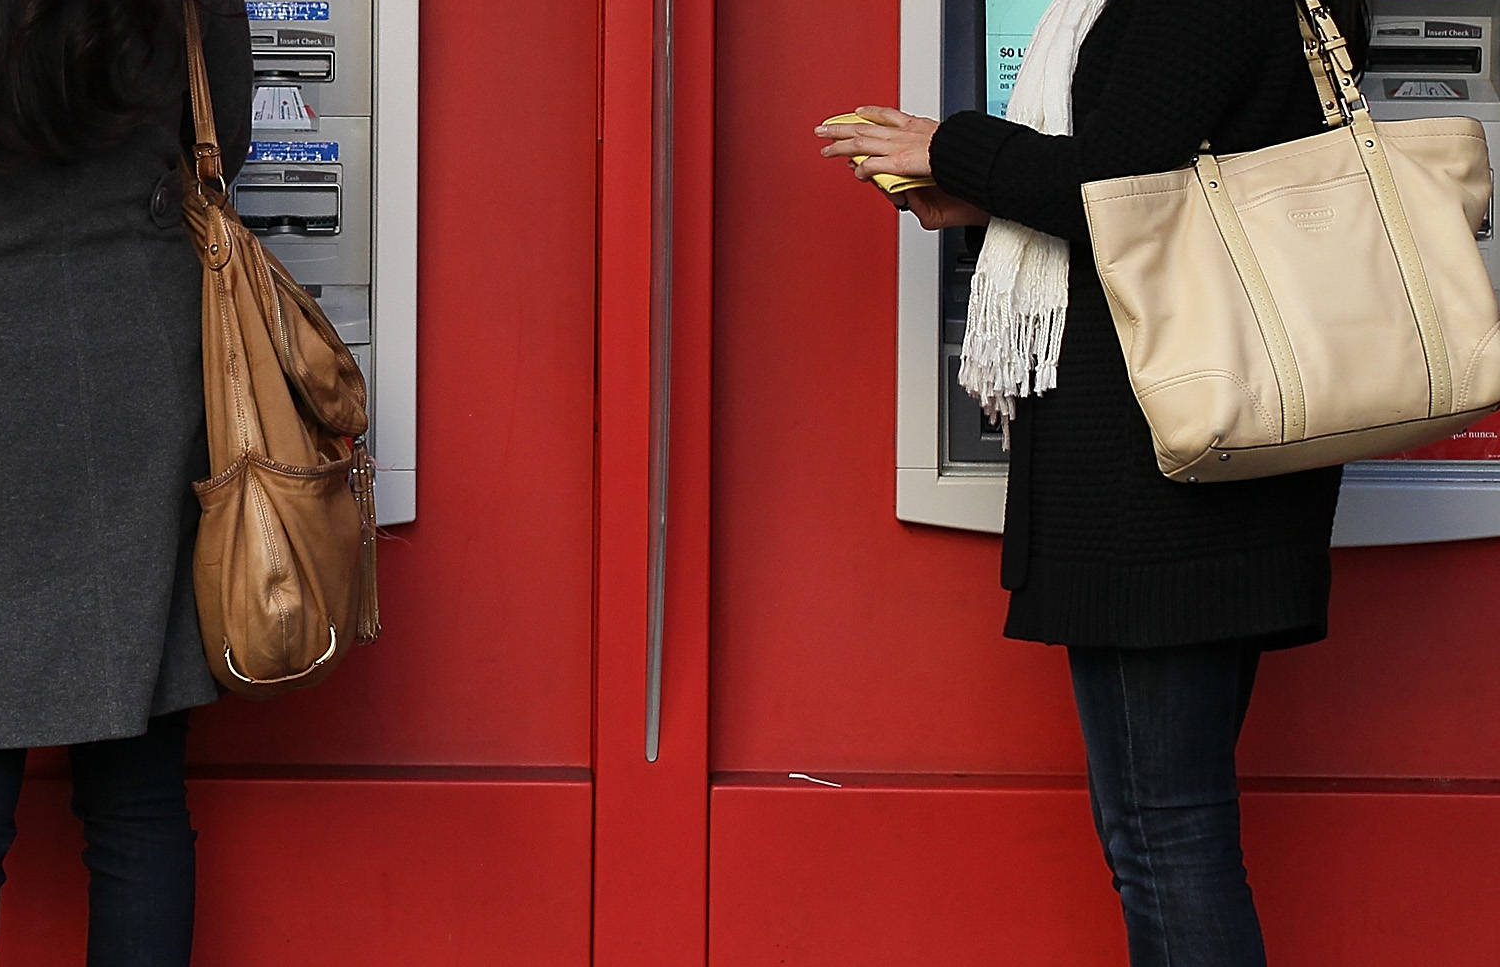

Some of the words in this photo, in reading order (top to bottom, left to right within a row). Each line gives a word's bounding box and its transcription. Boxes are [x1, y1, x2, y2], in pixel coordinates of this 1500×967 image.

[1427, 29, 1447, 37] Insert
[301, 38, 322, 46] Check
[1000, 47, 1015, 59] $0
